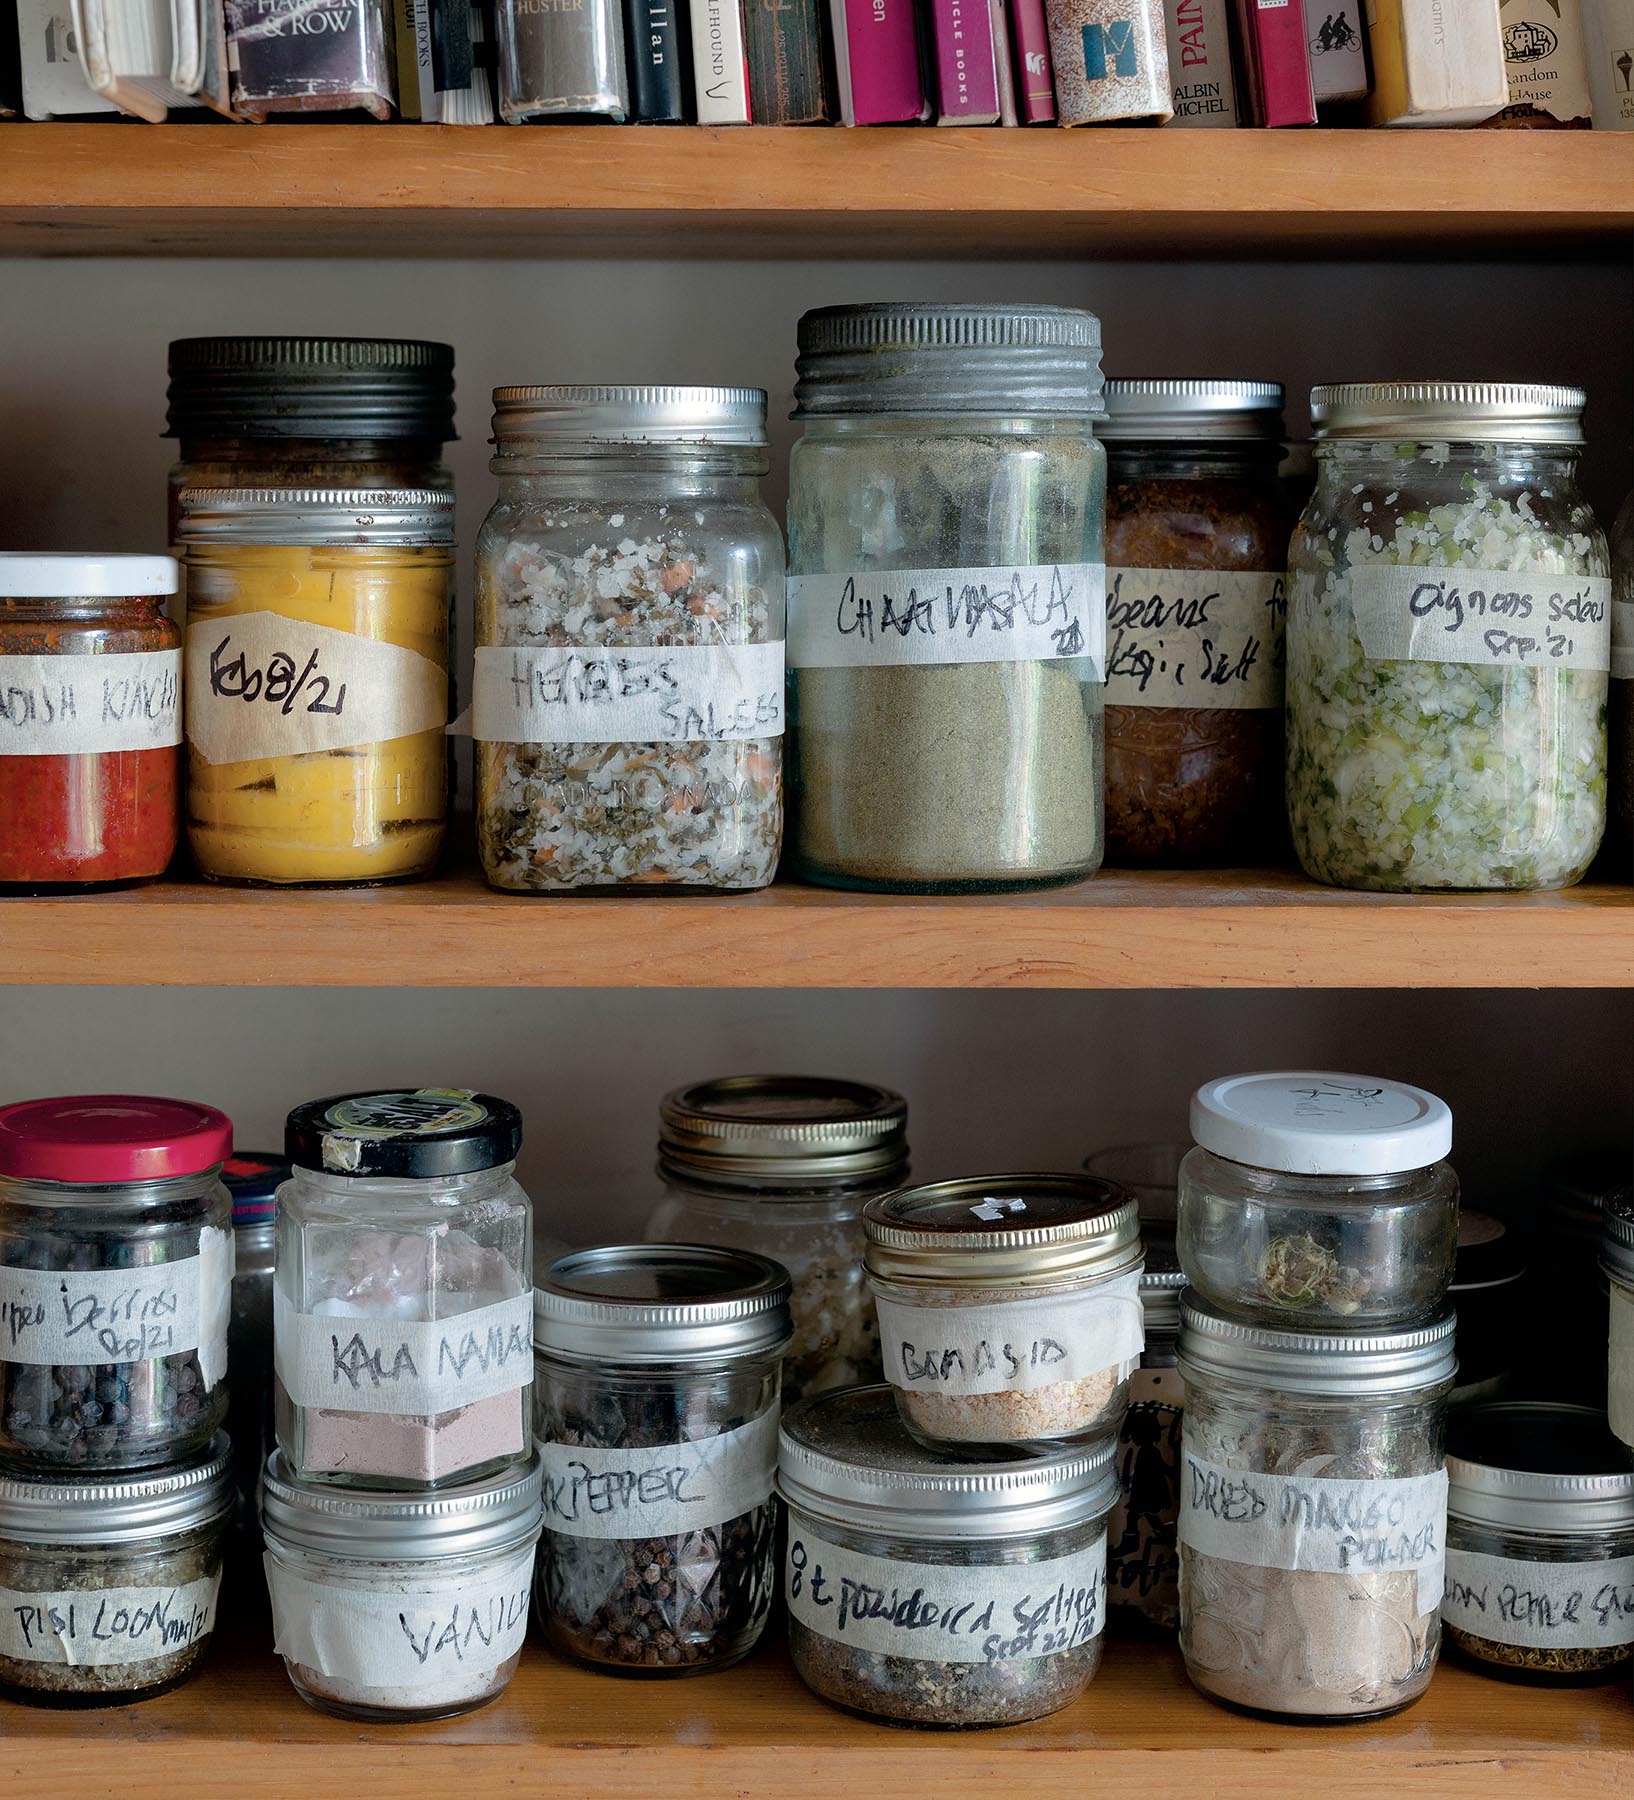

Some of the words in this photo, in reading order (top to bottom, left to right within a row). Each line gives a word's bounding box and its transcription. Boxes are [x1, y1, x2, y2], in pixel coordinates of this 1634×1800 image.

[263, 16, 287, 38] &
[291, 10, 352, 36] ROW
[417, 21, 430, 67] BOOKS
[650, 0, 668, 65] llan
[1431, 0, 1446, 45] artin's
[956, 49, 969, 104] BOOKS
[1174, 83, 1220, 101] ALBIN
[1171, 99, 1229, 118] MICHEL
